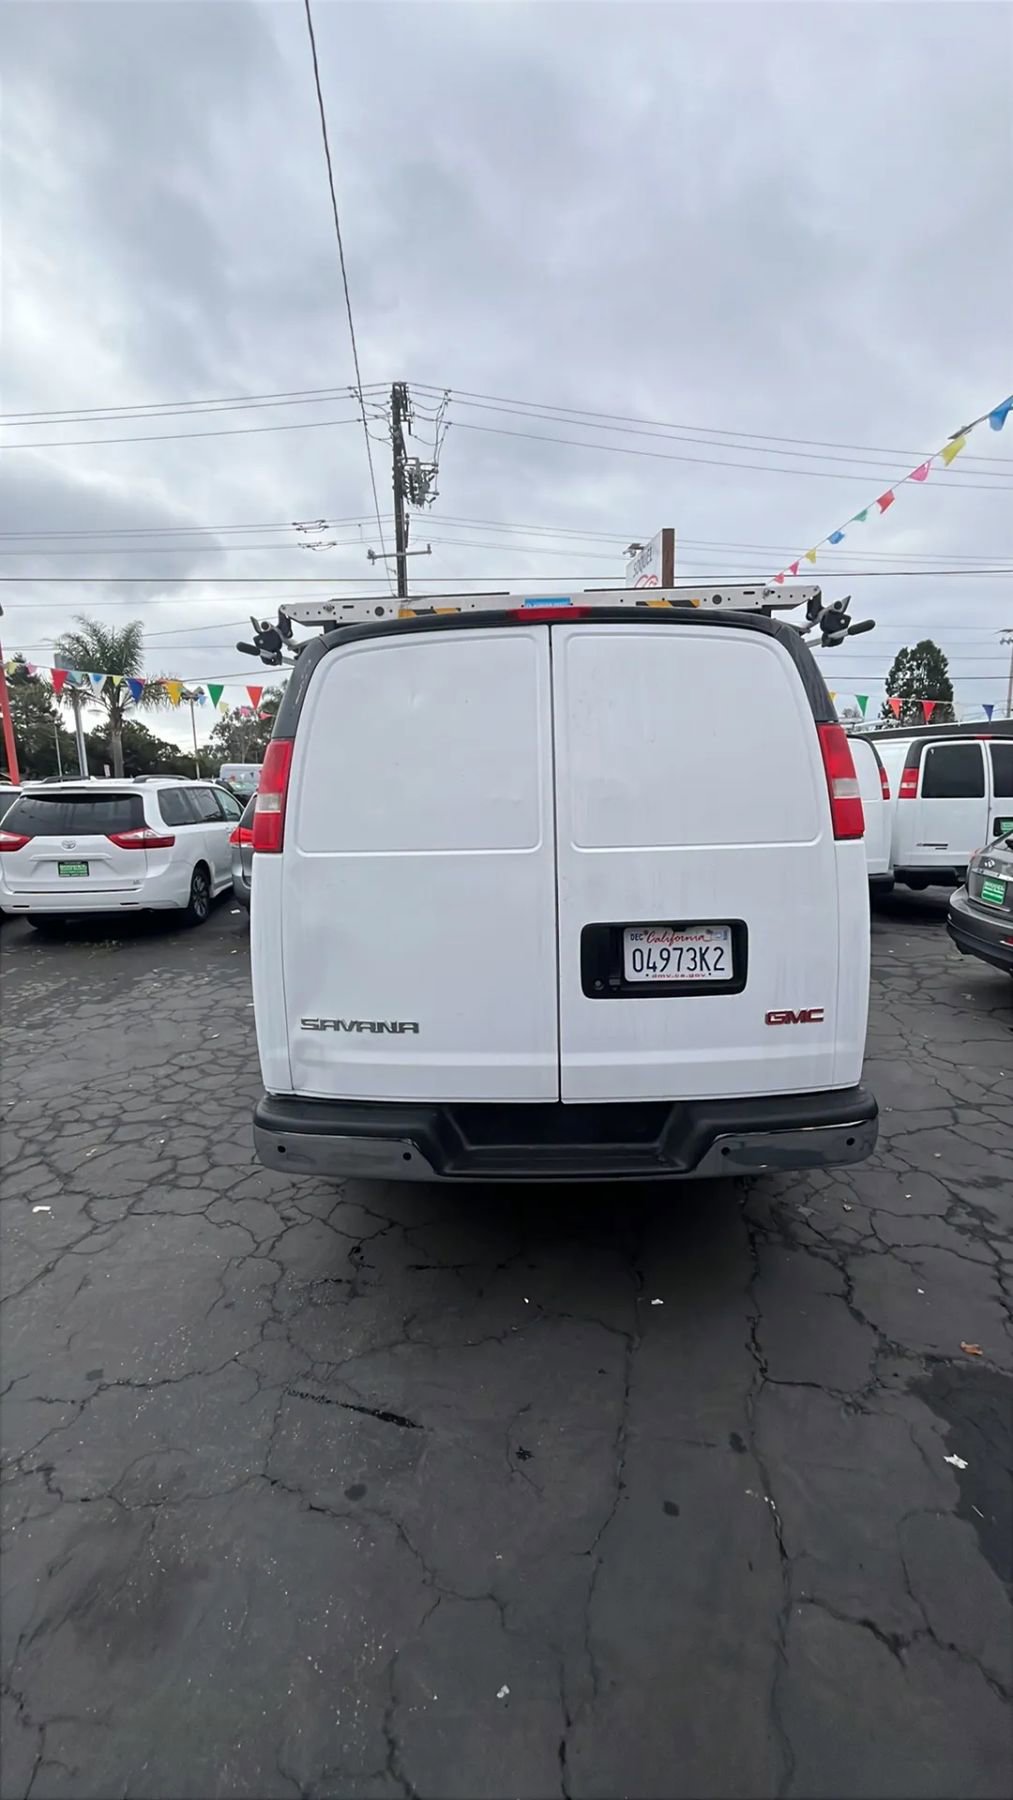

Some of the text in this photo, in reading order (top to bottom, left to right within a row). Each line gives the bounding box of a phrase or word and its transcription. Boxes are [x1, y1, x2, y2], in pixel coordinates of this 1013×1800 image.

[630, 933, 644, 941] DEC
[646, 930, 705, 946] California
[632, 946, 725, 973] 04973K2
[765, 1008, 824, 1026] GMC
[300, 1018, 419, 1034] SAVANA
